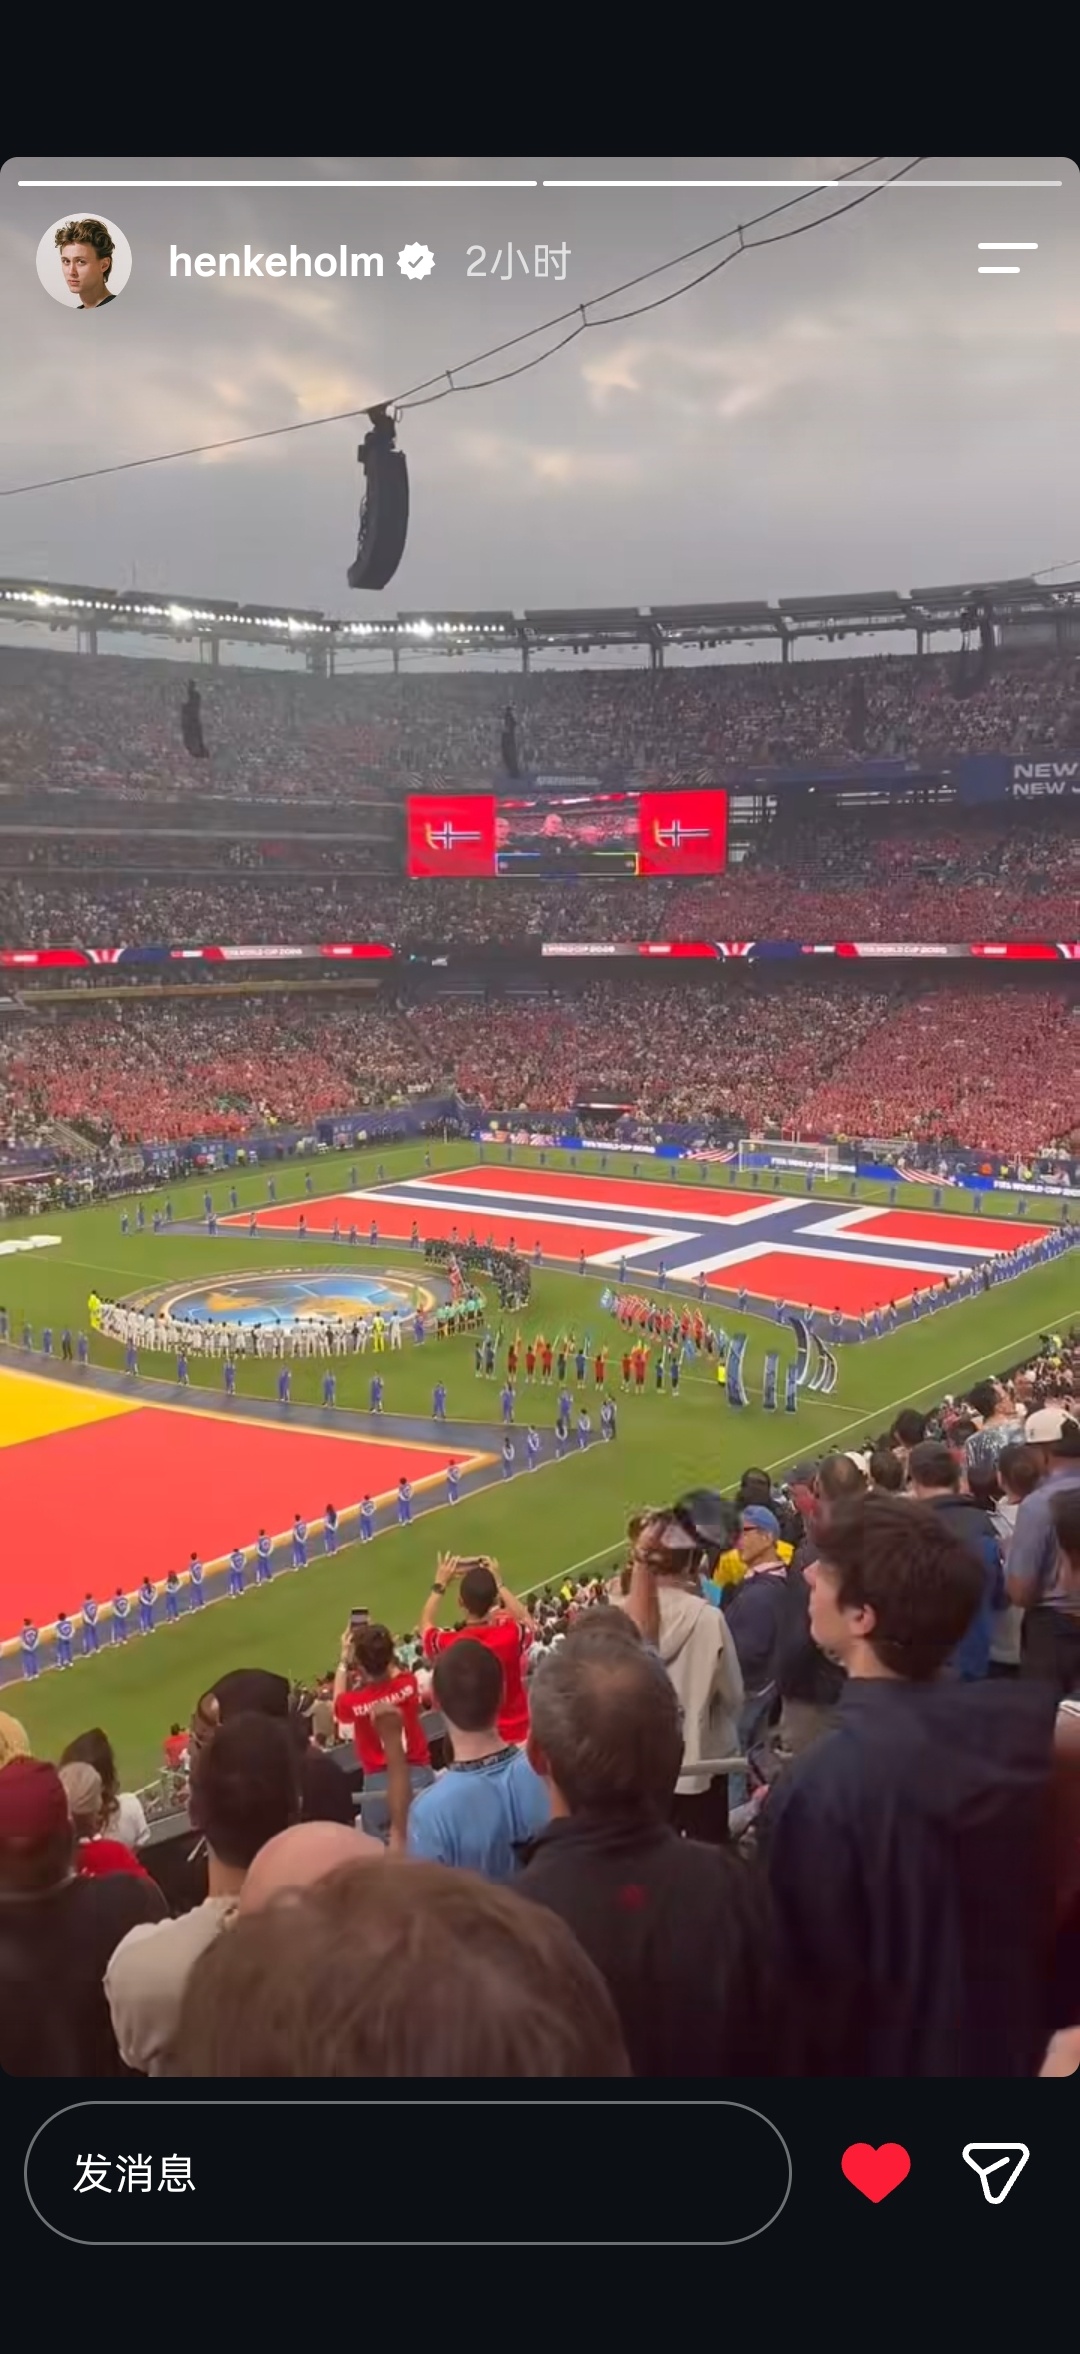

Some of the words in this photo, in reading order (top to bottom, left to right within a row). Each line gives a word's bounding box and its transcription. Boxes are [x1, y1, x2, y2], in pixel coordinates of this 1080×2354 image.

[1014, 763, 1078, 778] NEW
[1012, 781, 1066, 795] NEW
[994, 1180, 1011, 1190] FIFA
[1012, 1182, 1043, 1192] WORLD
[1044, 1186, 1062, 1194] CUP
